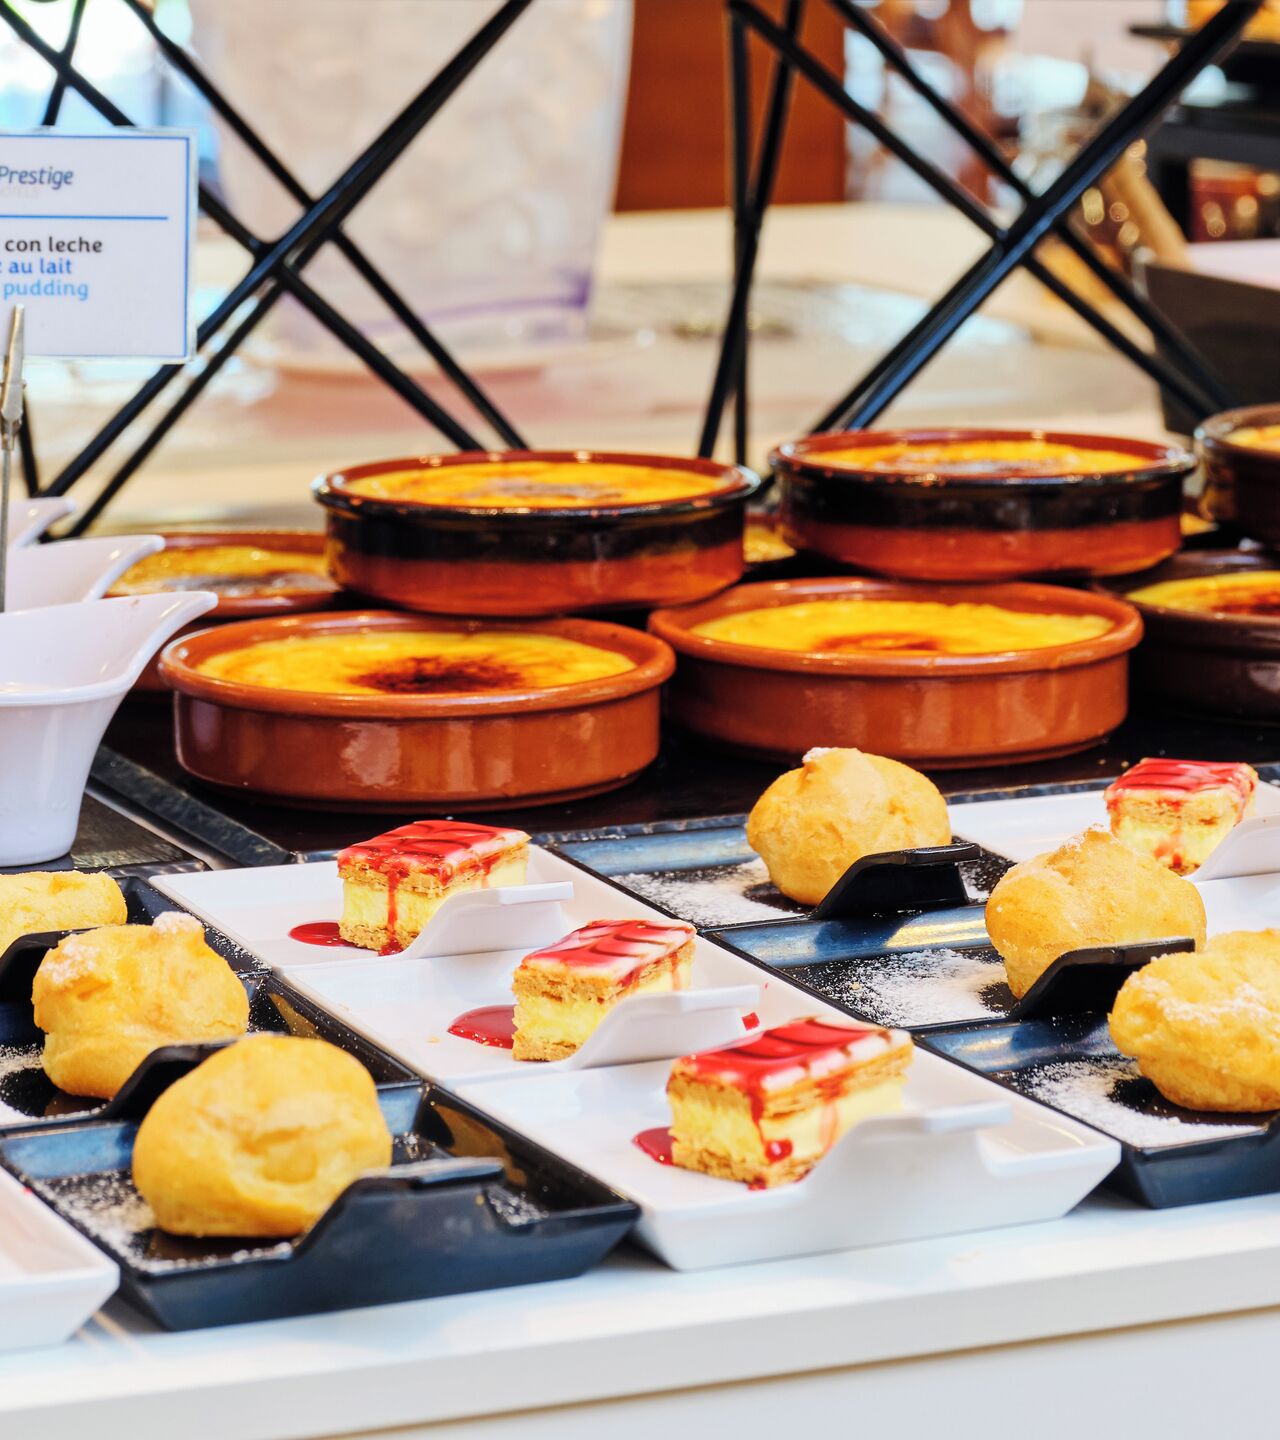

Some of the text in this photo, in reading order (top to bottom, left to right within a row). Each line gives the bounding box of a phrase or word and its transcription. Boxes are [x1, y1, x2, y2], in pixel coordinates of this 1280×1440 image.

[5, 239, 42, 252] con
[48, 236, 103, 253] leche
[8, 261, 33, 274] au
[39, 257, 73, 274] lait
[3, 279, 89, 301] pudding
